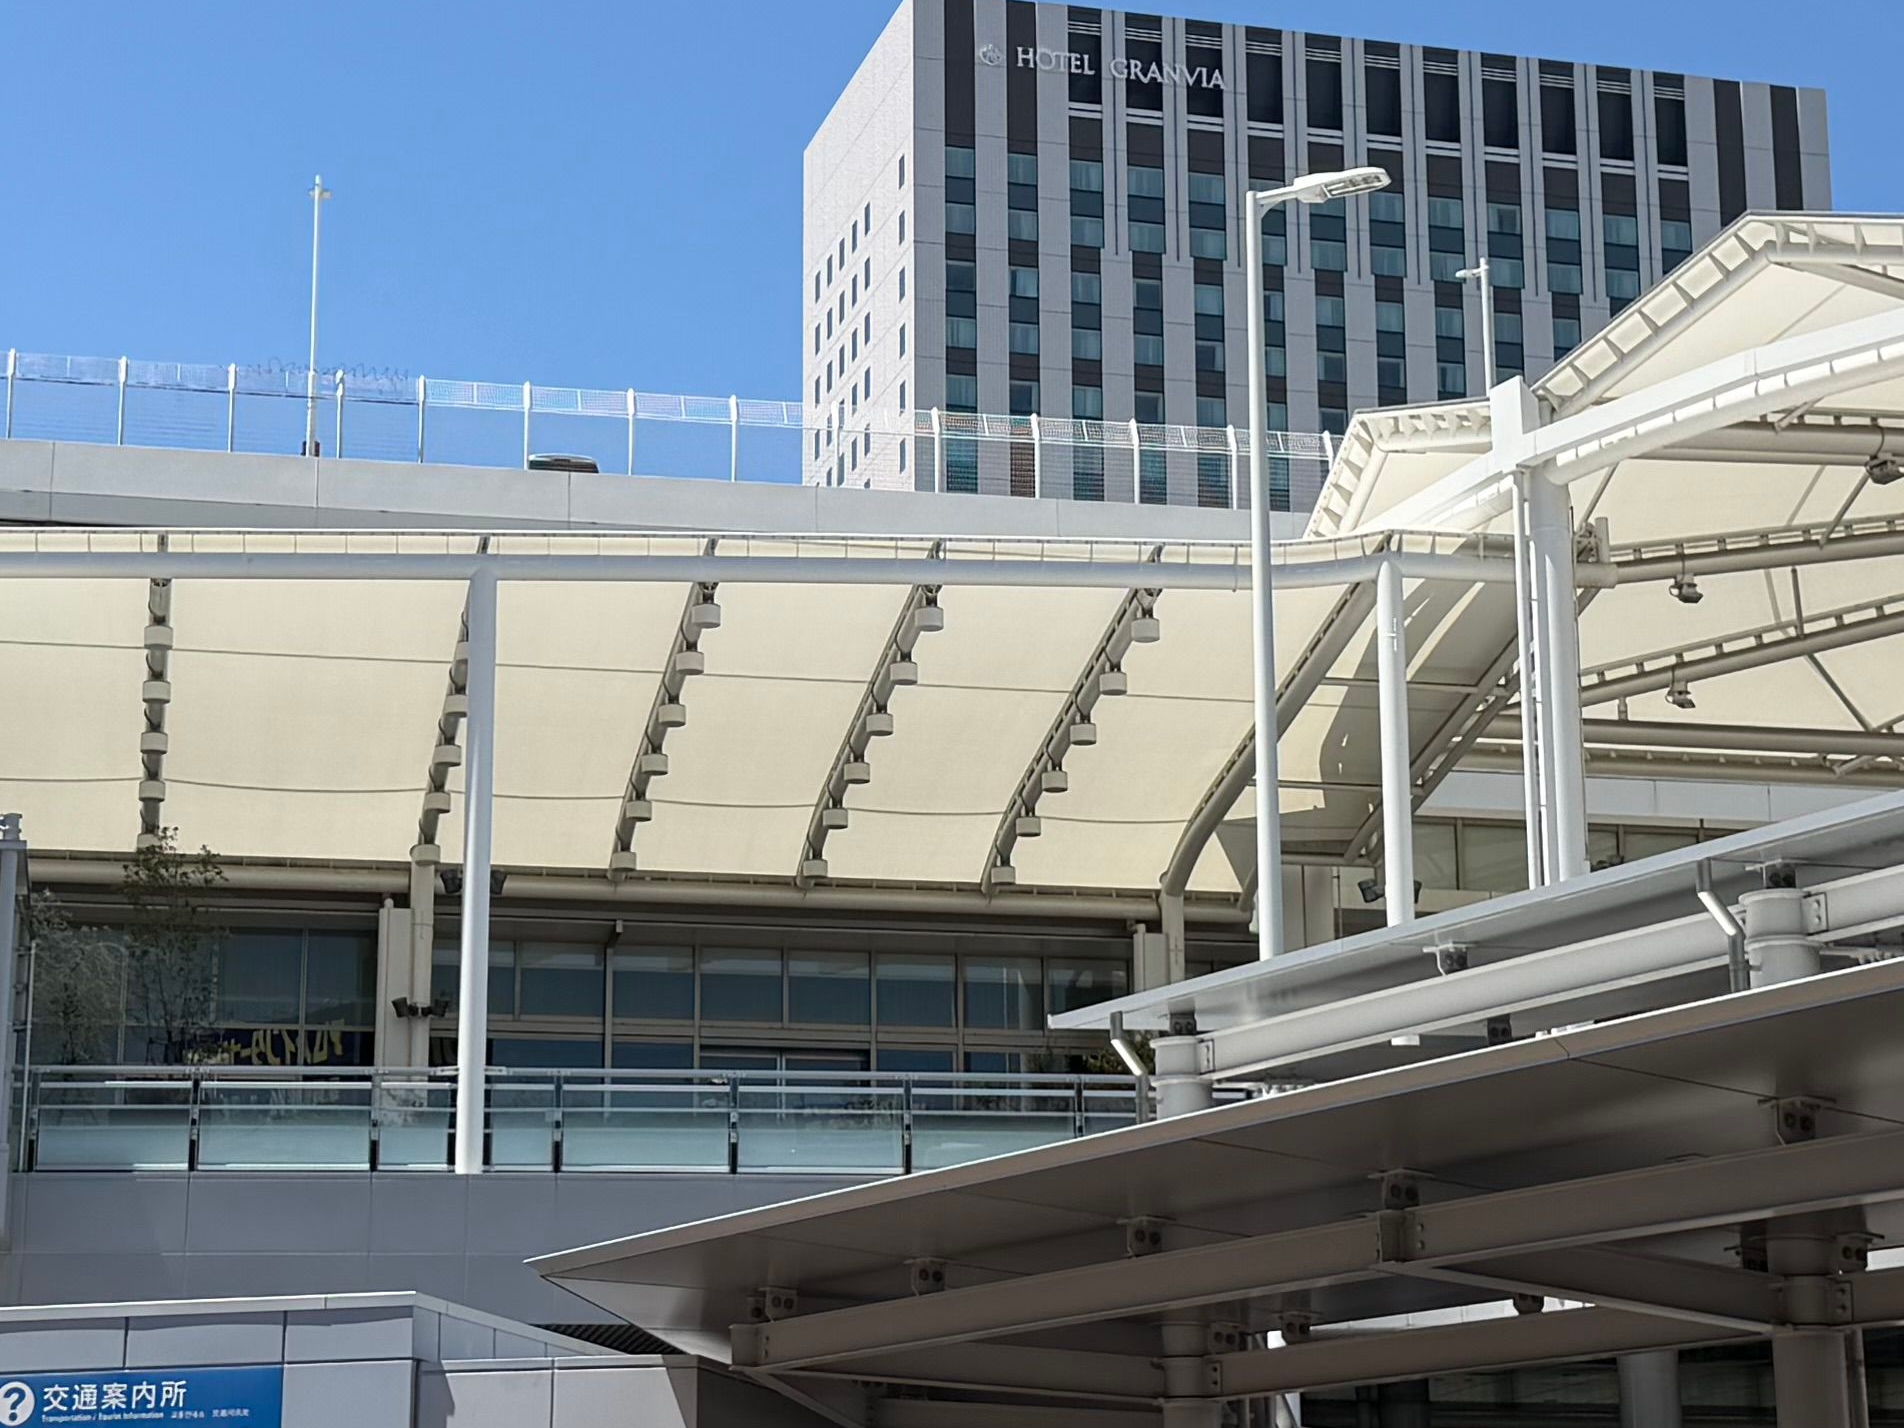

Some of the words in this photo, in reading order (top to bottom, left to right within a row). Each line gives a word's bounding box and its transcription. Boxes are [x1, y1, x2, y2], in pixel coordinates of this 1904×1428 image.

[1015, 46, 1095, 76] HOTEL
[1110, 58, 1227, 90] GRANVIA
[41, 1380, 188, 1412] 交通案内所
